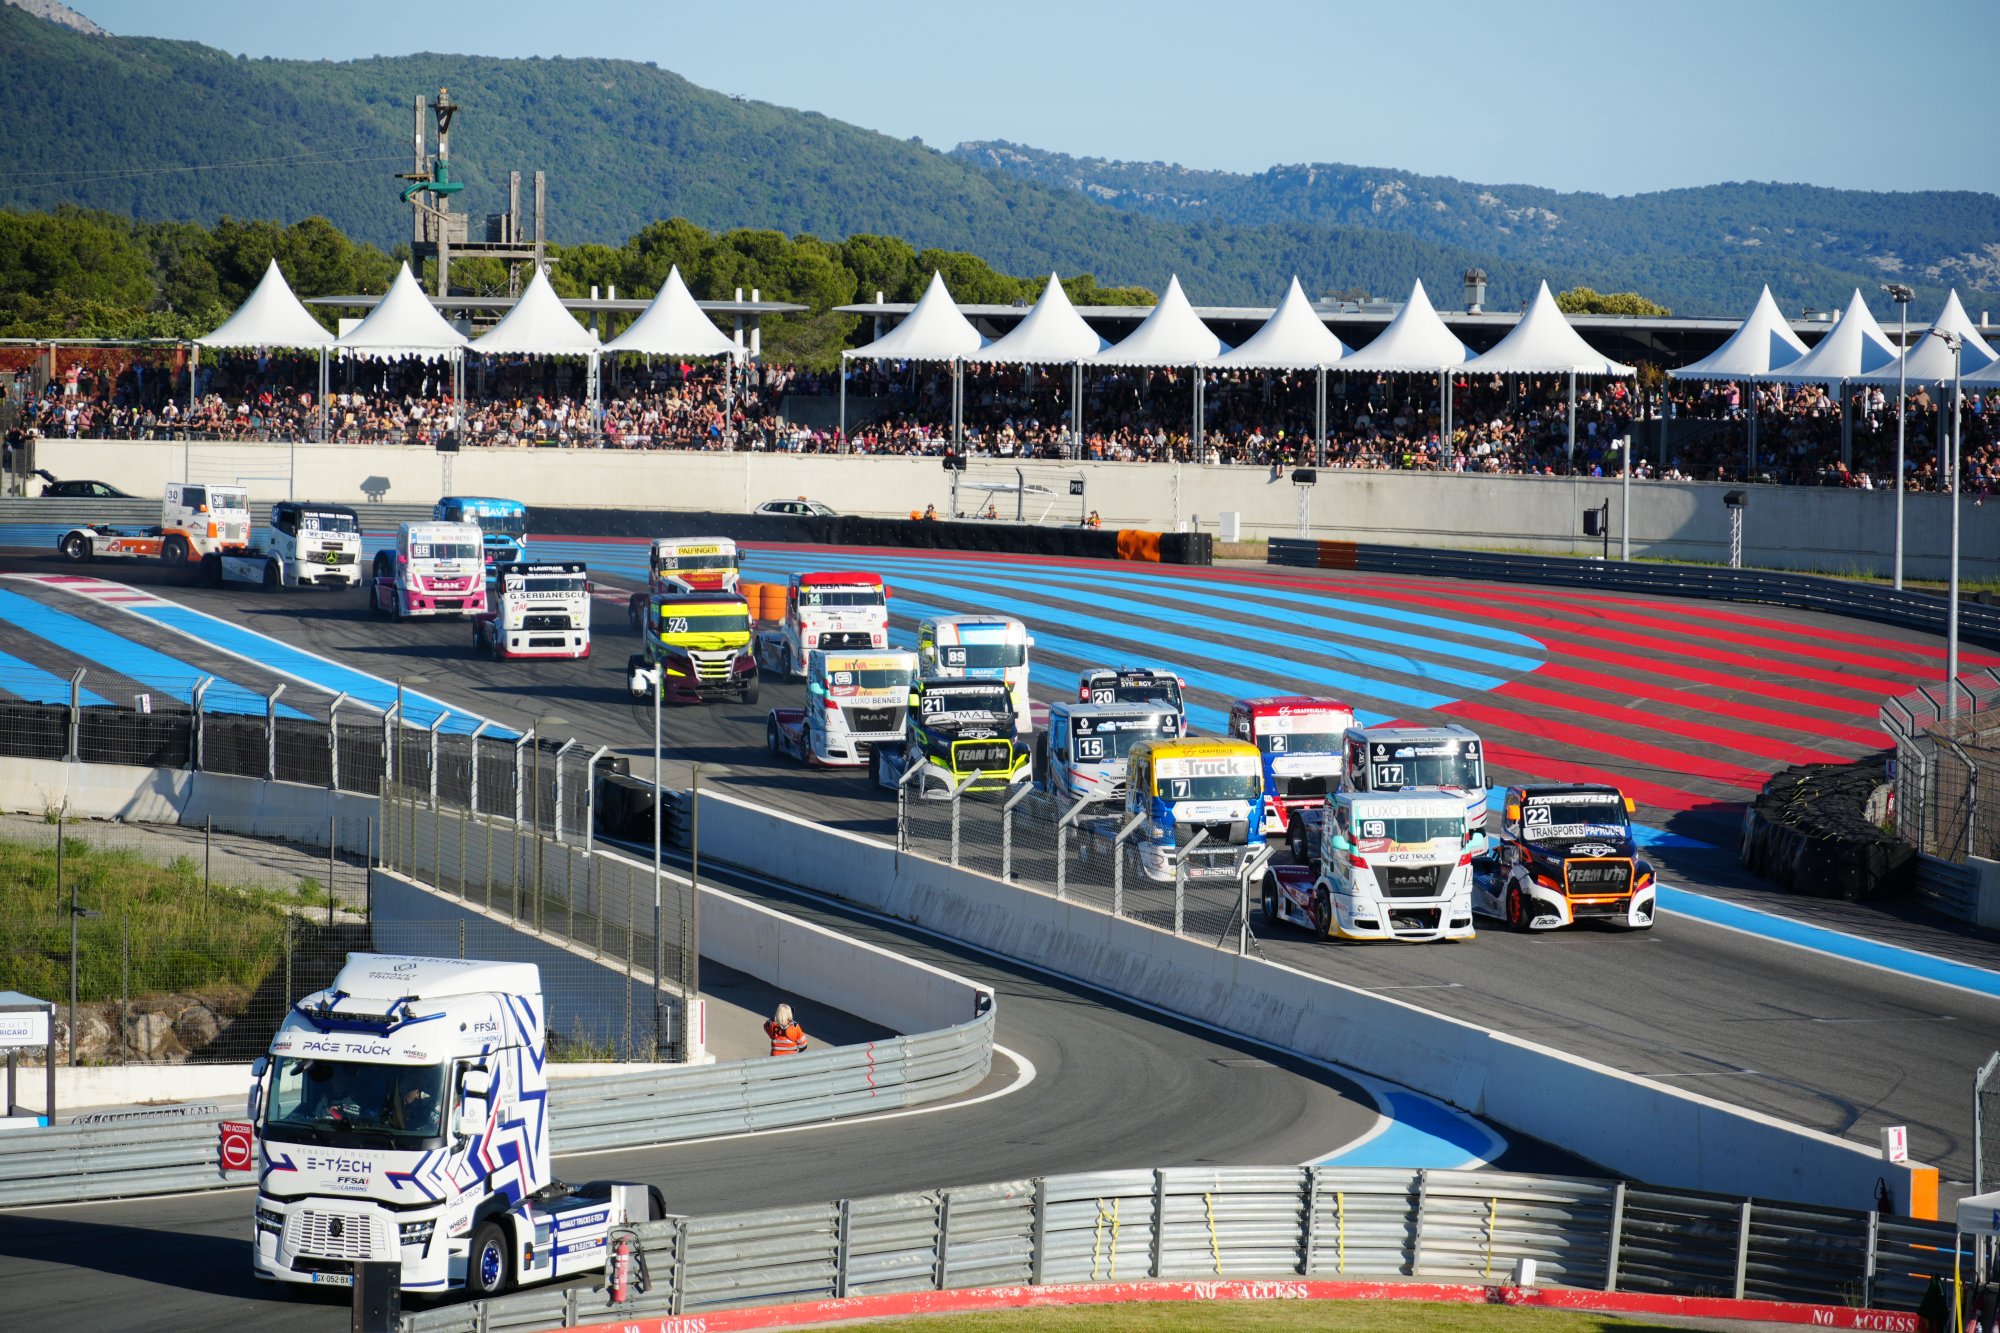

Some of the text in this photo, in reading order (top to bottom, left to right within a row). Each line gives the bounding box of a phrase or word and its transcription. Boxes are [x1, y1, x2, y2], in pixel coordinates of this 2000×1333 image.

[1070, 483, 1082, 494] P15
[168, 490, 179, 500] 30
[305, 519, 319, 530] 19
[415, 545, 430, 555] 66
[678, 546, 718, 555] PALFINGER
[433, 582, 459, 590] MAN
[508, 580, 523, 590] 71
[808, 593, 821, 604] 14
[668, 617, 688, 633] 74
[948, 651, 965, 663] 89
[845, 659, 868, 670] HYVA
[850, 696, 902, 705] LUXO BENNES
[1094, 691, 1112, 704] 20
[923, 699, 941, 712] 21
[1082, 741, 1101, 755] 15
[1272, 737, 1285, 751] 2
[958, 749, 986, 760] TEAM
[1184, 758, 1239, 776] Truck
[1380, 767, 1401, 782] 17
[1174, 781, 1187, 797] 7
[1367, 805, 1449, 818] LUXO BENNES
[1526, 808, 1550, 824] 22
[1366, 822, 1384, 835] 48
[1531, 825, 1584, 839] TRANSPORTS
[1394, 875, 1430, 885] MAN
[1569, 867, 1628, 883] TEAM VTR
[411, 957, 477, 966] ELECTRIC
[474, 1023, 497, 1033] FFSA
[302, 1041, 392, 1056] PACE TRUCK
[402, 1049, 428, 1057] WHEELS
[223, 1123, 251, 1135] NO ACCESS
[296, 1147, 386, 1160] RENAULT TRUCKS
[307, 1157, 372, 1174] E-TECH
[337, 1176, 366, 1185] FFSA
[559, 1218, 576, 1230] RENAULT
[316, 1274, 349, 1284] GX-052-BX
[1239, 1282, 1309, 1300] ACCESS
[660, 1318, 706, 1333] ACCESS
[1812, 1309, 1916, 1333] NO ACCESS
